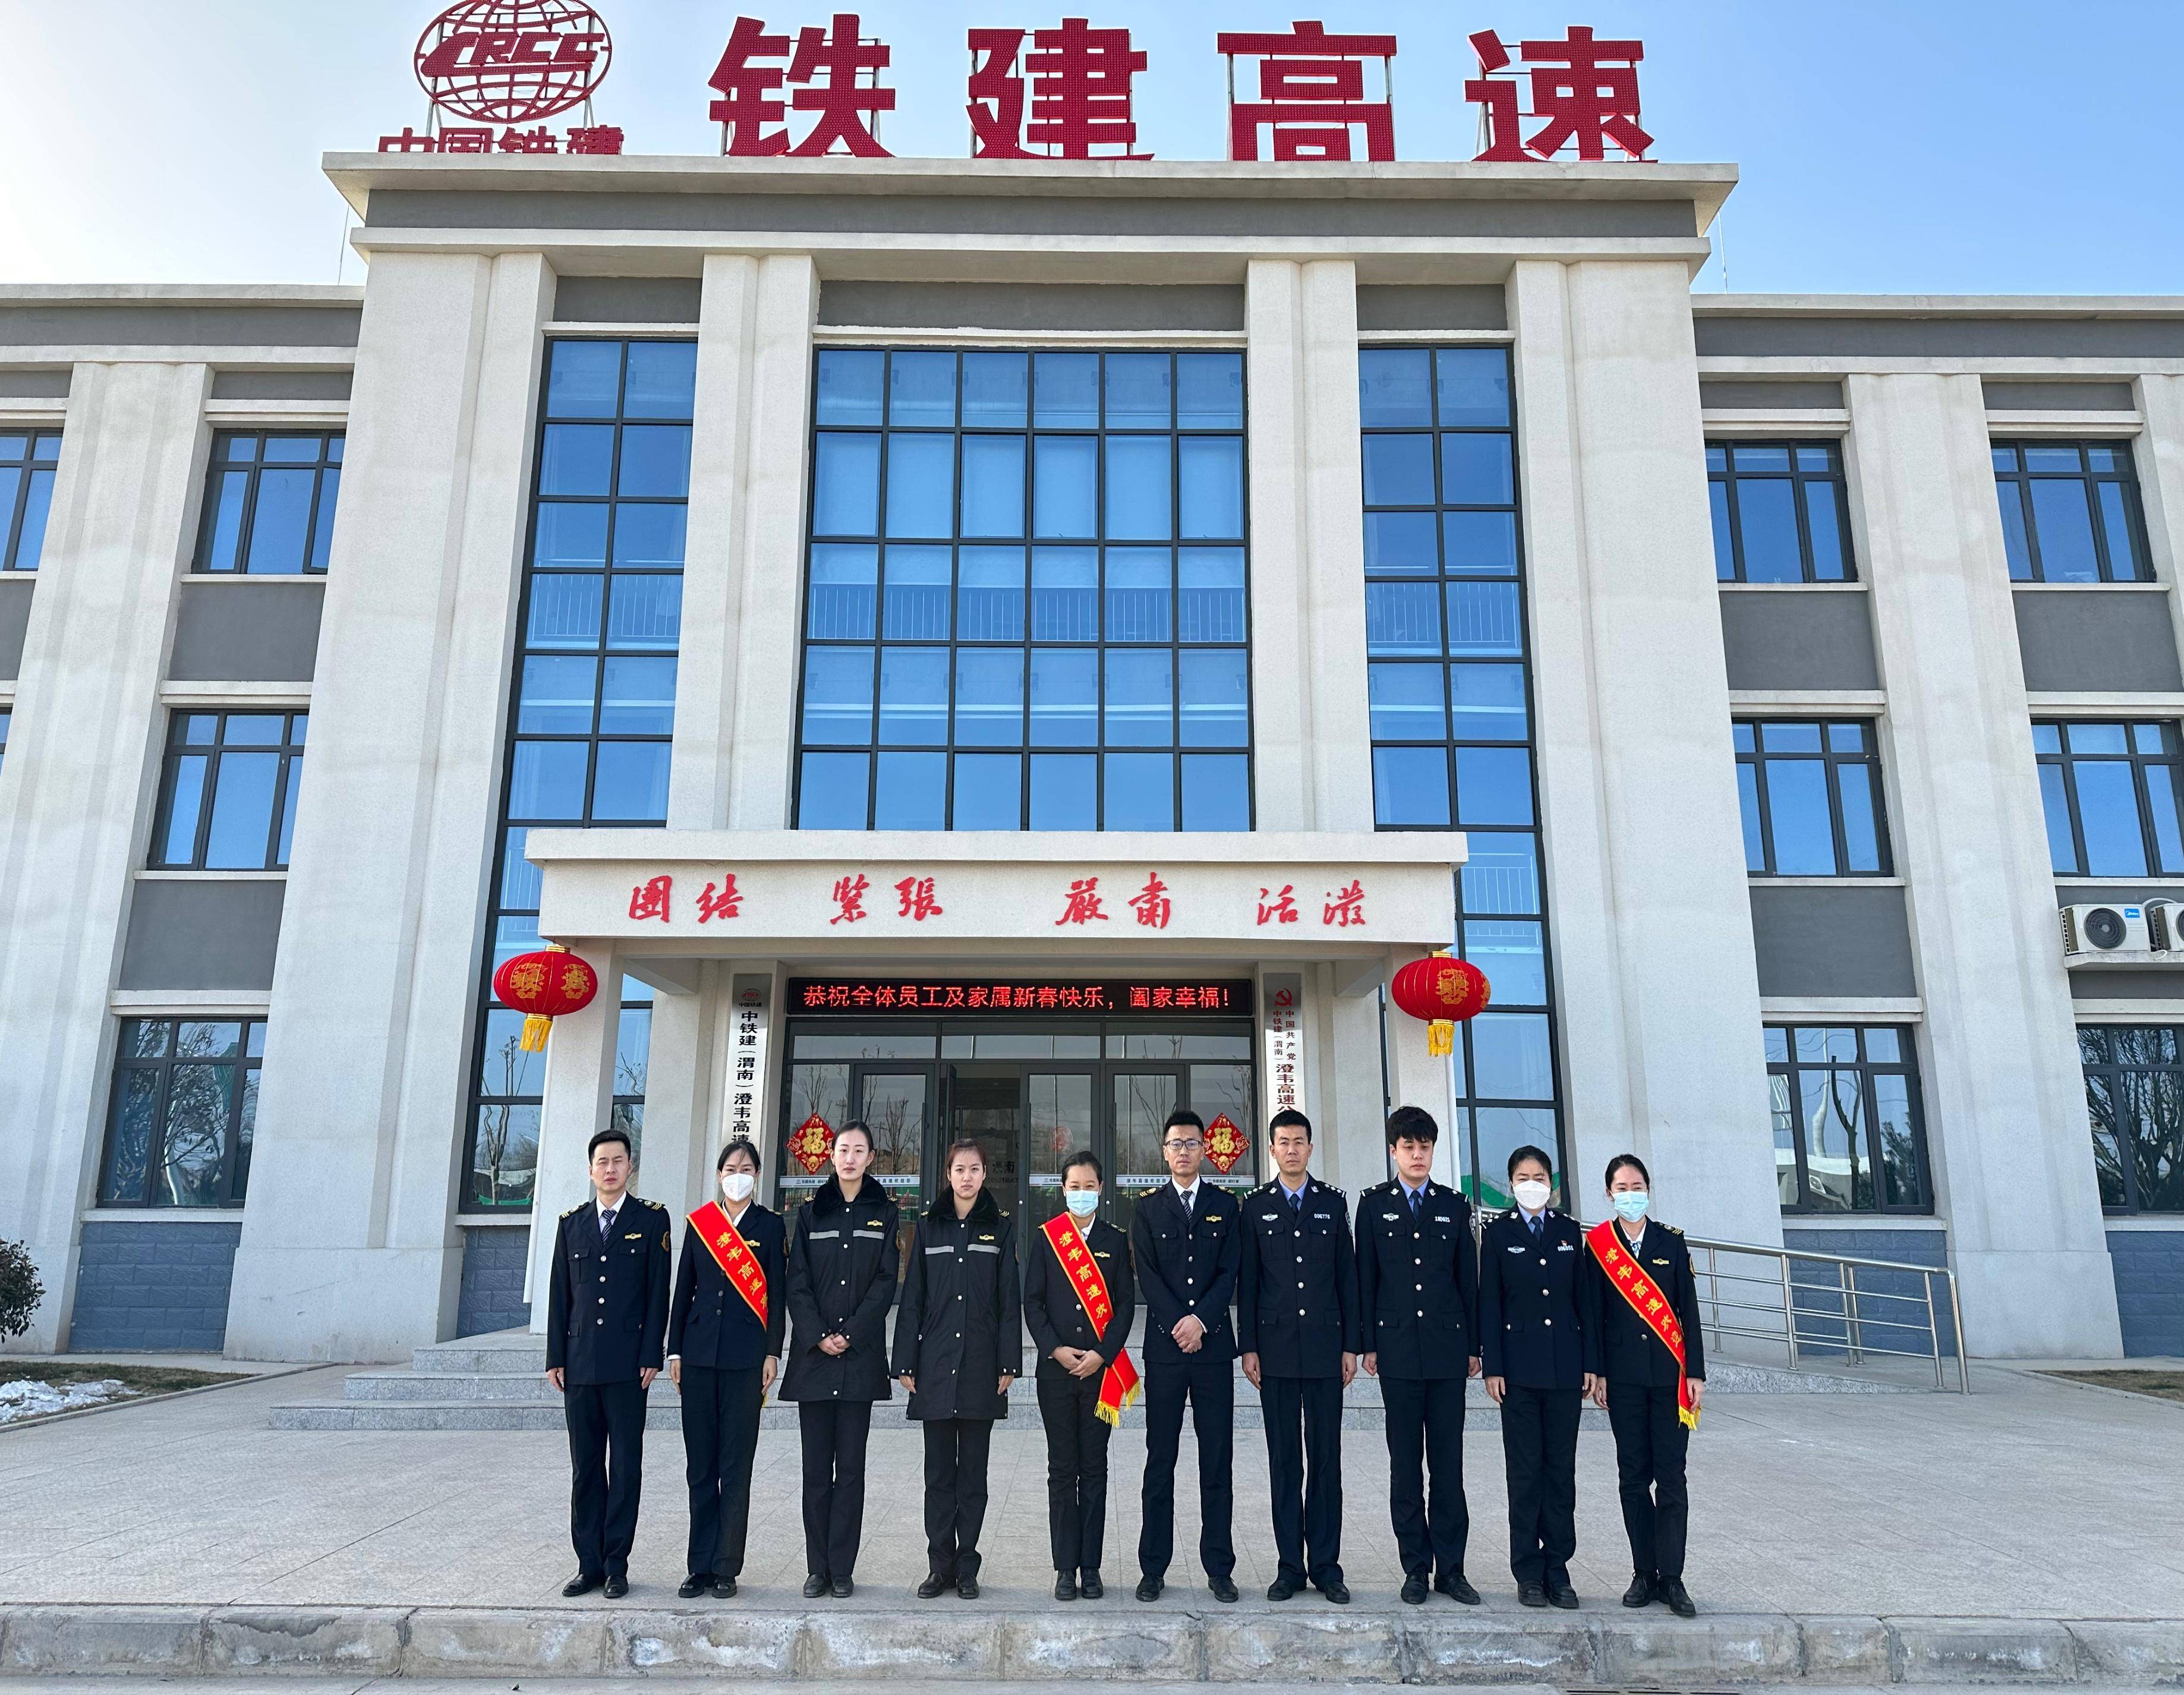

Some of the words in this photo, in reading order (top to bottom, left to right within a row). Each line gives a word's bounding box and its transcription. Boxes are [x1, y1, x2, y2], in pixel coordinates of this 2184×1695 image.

[421, 31, 605, 77] CRCC
[707, 14, 1659, 164] 铁建高速
[379, 125, 625, 155] 中国铁建
[1285, 1010, 1296, 1060] 中国共产党
[1605, 1247, 1685, 1356] 澄韦高速欢迎
